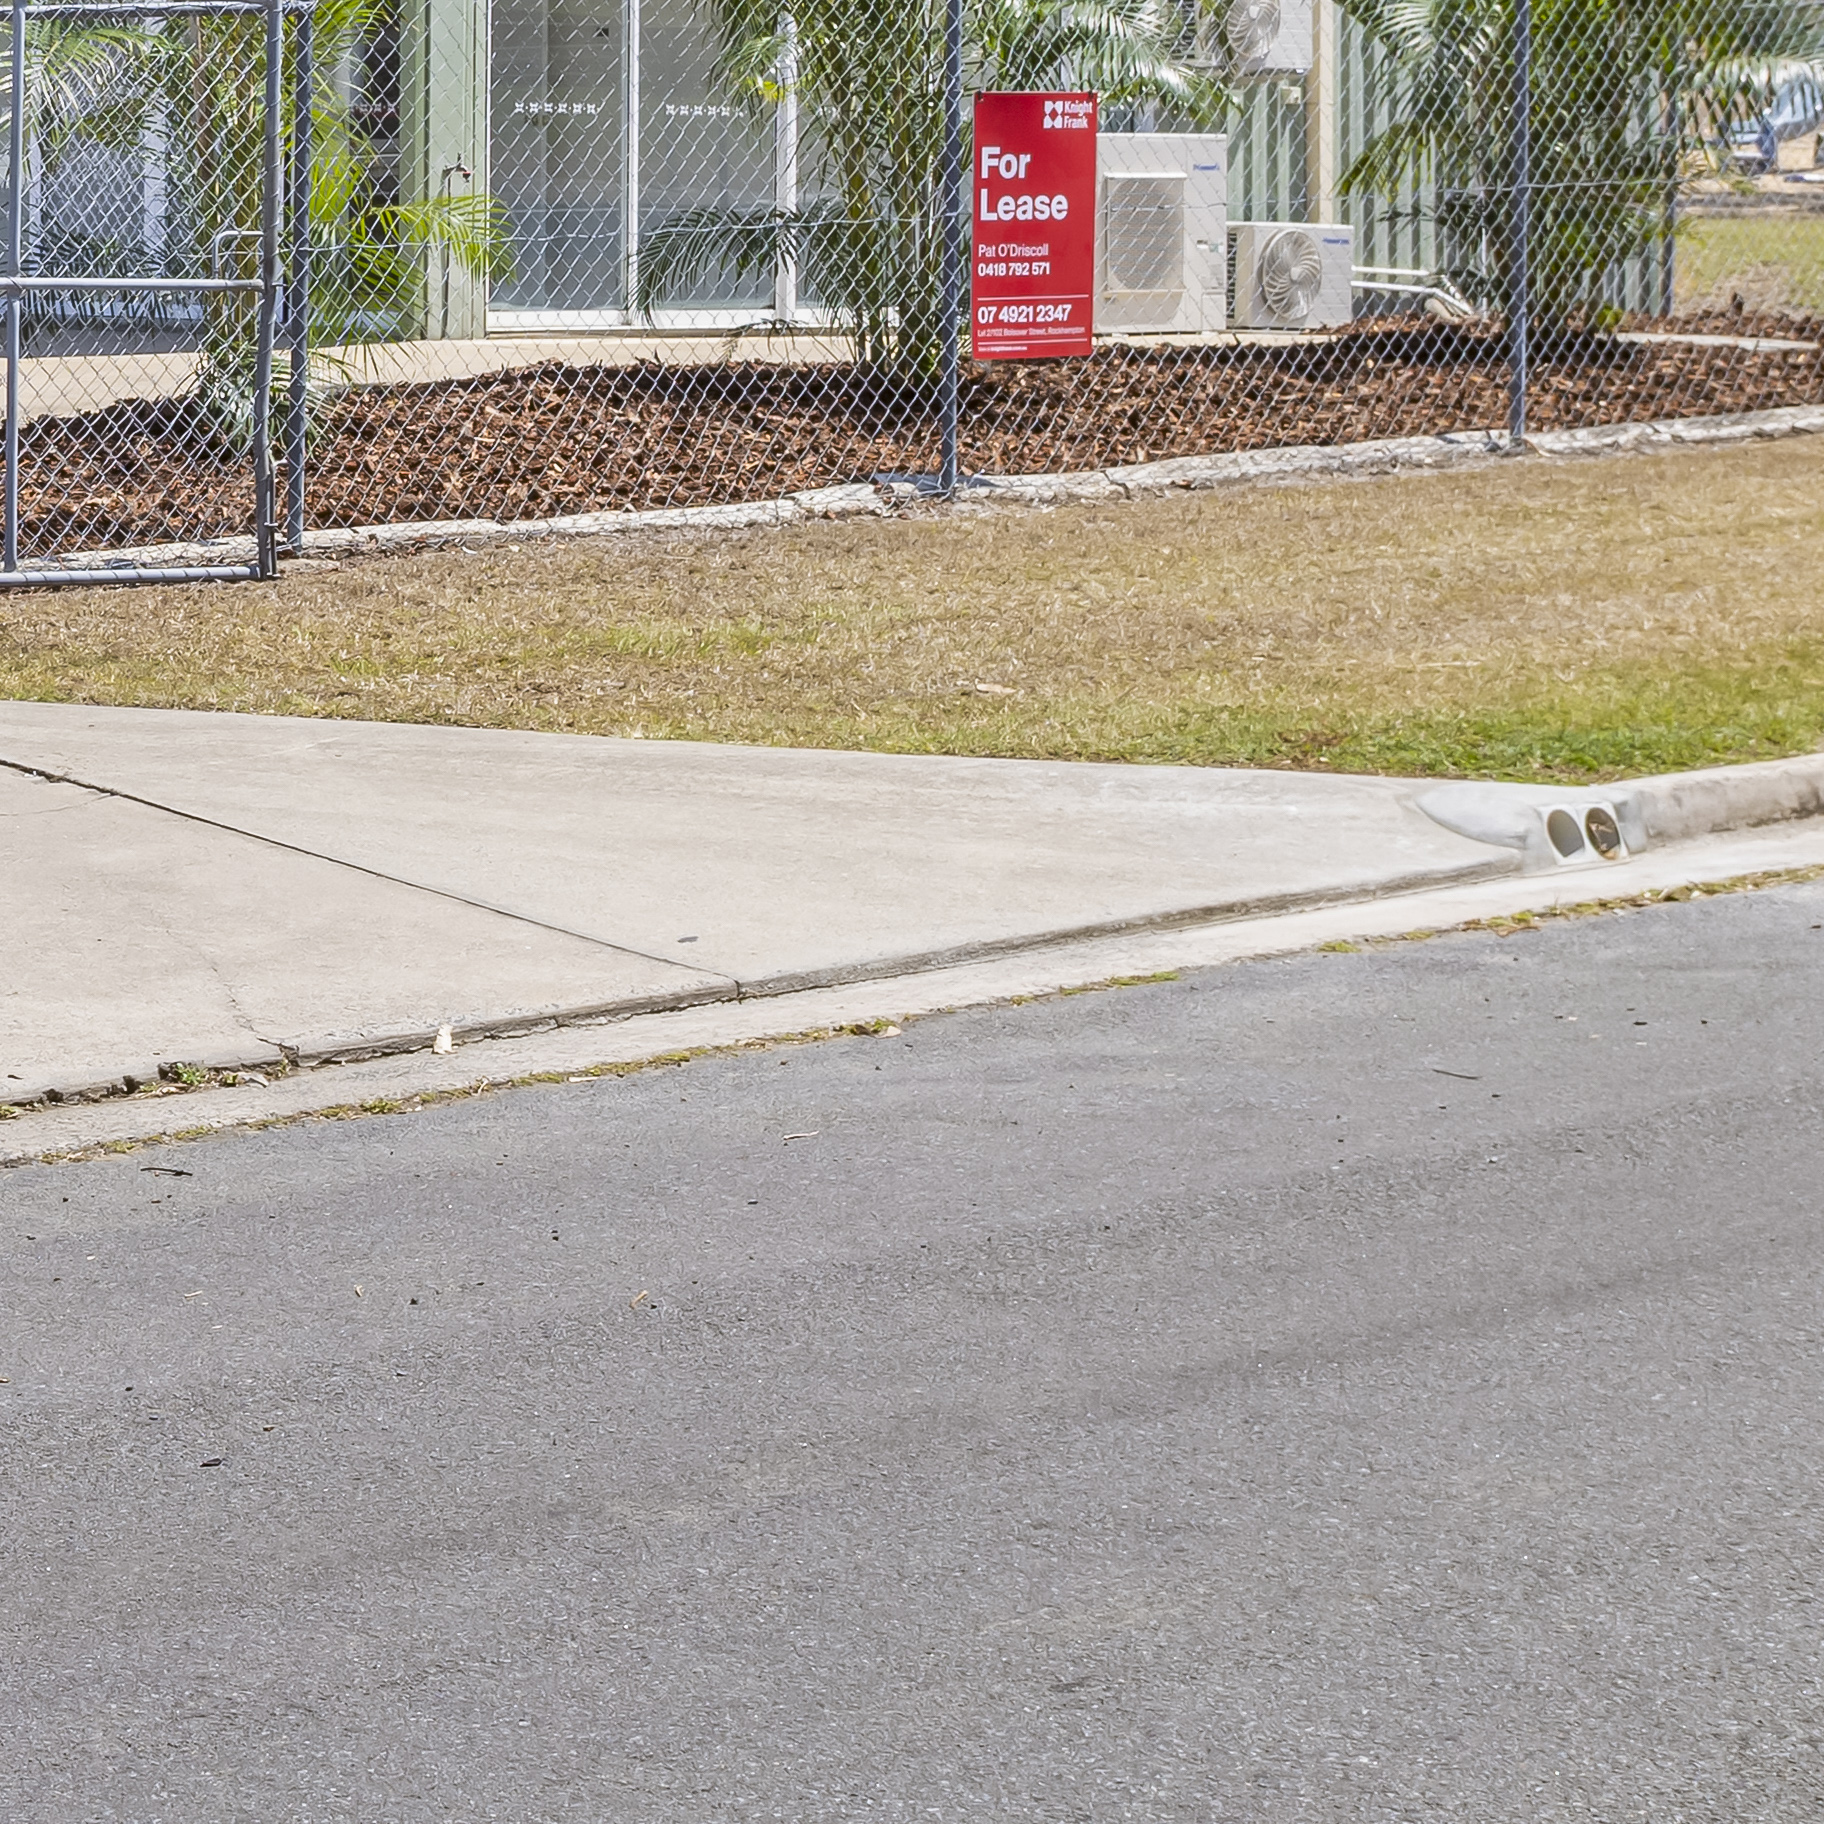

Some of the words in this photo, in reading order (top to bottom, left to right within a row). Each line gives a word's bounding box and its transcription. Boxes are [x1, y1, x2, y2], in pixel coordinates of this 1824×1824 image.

[1064, 100, 1093, 116] Knight
[1063, 116, 1089, 128] Frank
[981, 146, 1031, 179] For
[980, 188, 1069, 221] Lease
[978, 244, 996, 257] Pat
[998, 243, 1049, 257] O'Driscoll
[978, 262, 1006, 276] 0418
[1008, 262, 1030, 276] 792
[1031, 262, 1050, 275] 571
[977, 306, 997, 323] 07
[998, 305, 1033, 323] 4921
[1036, 304, 1072, 322] 2347
